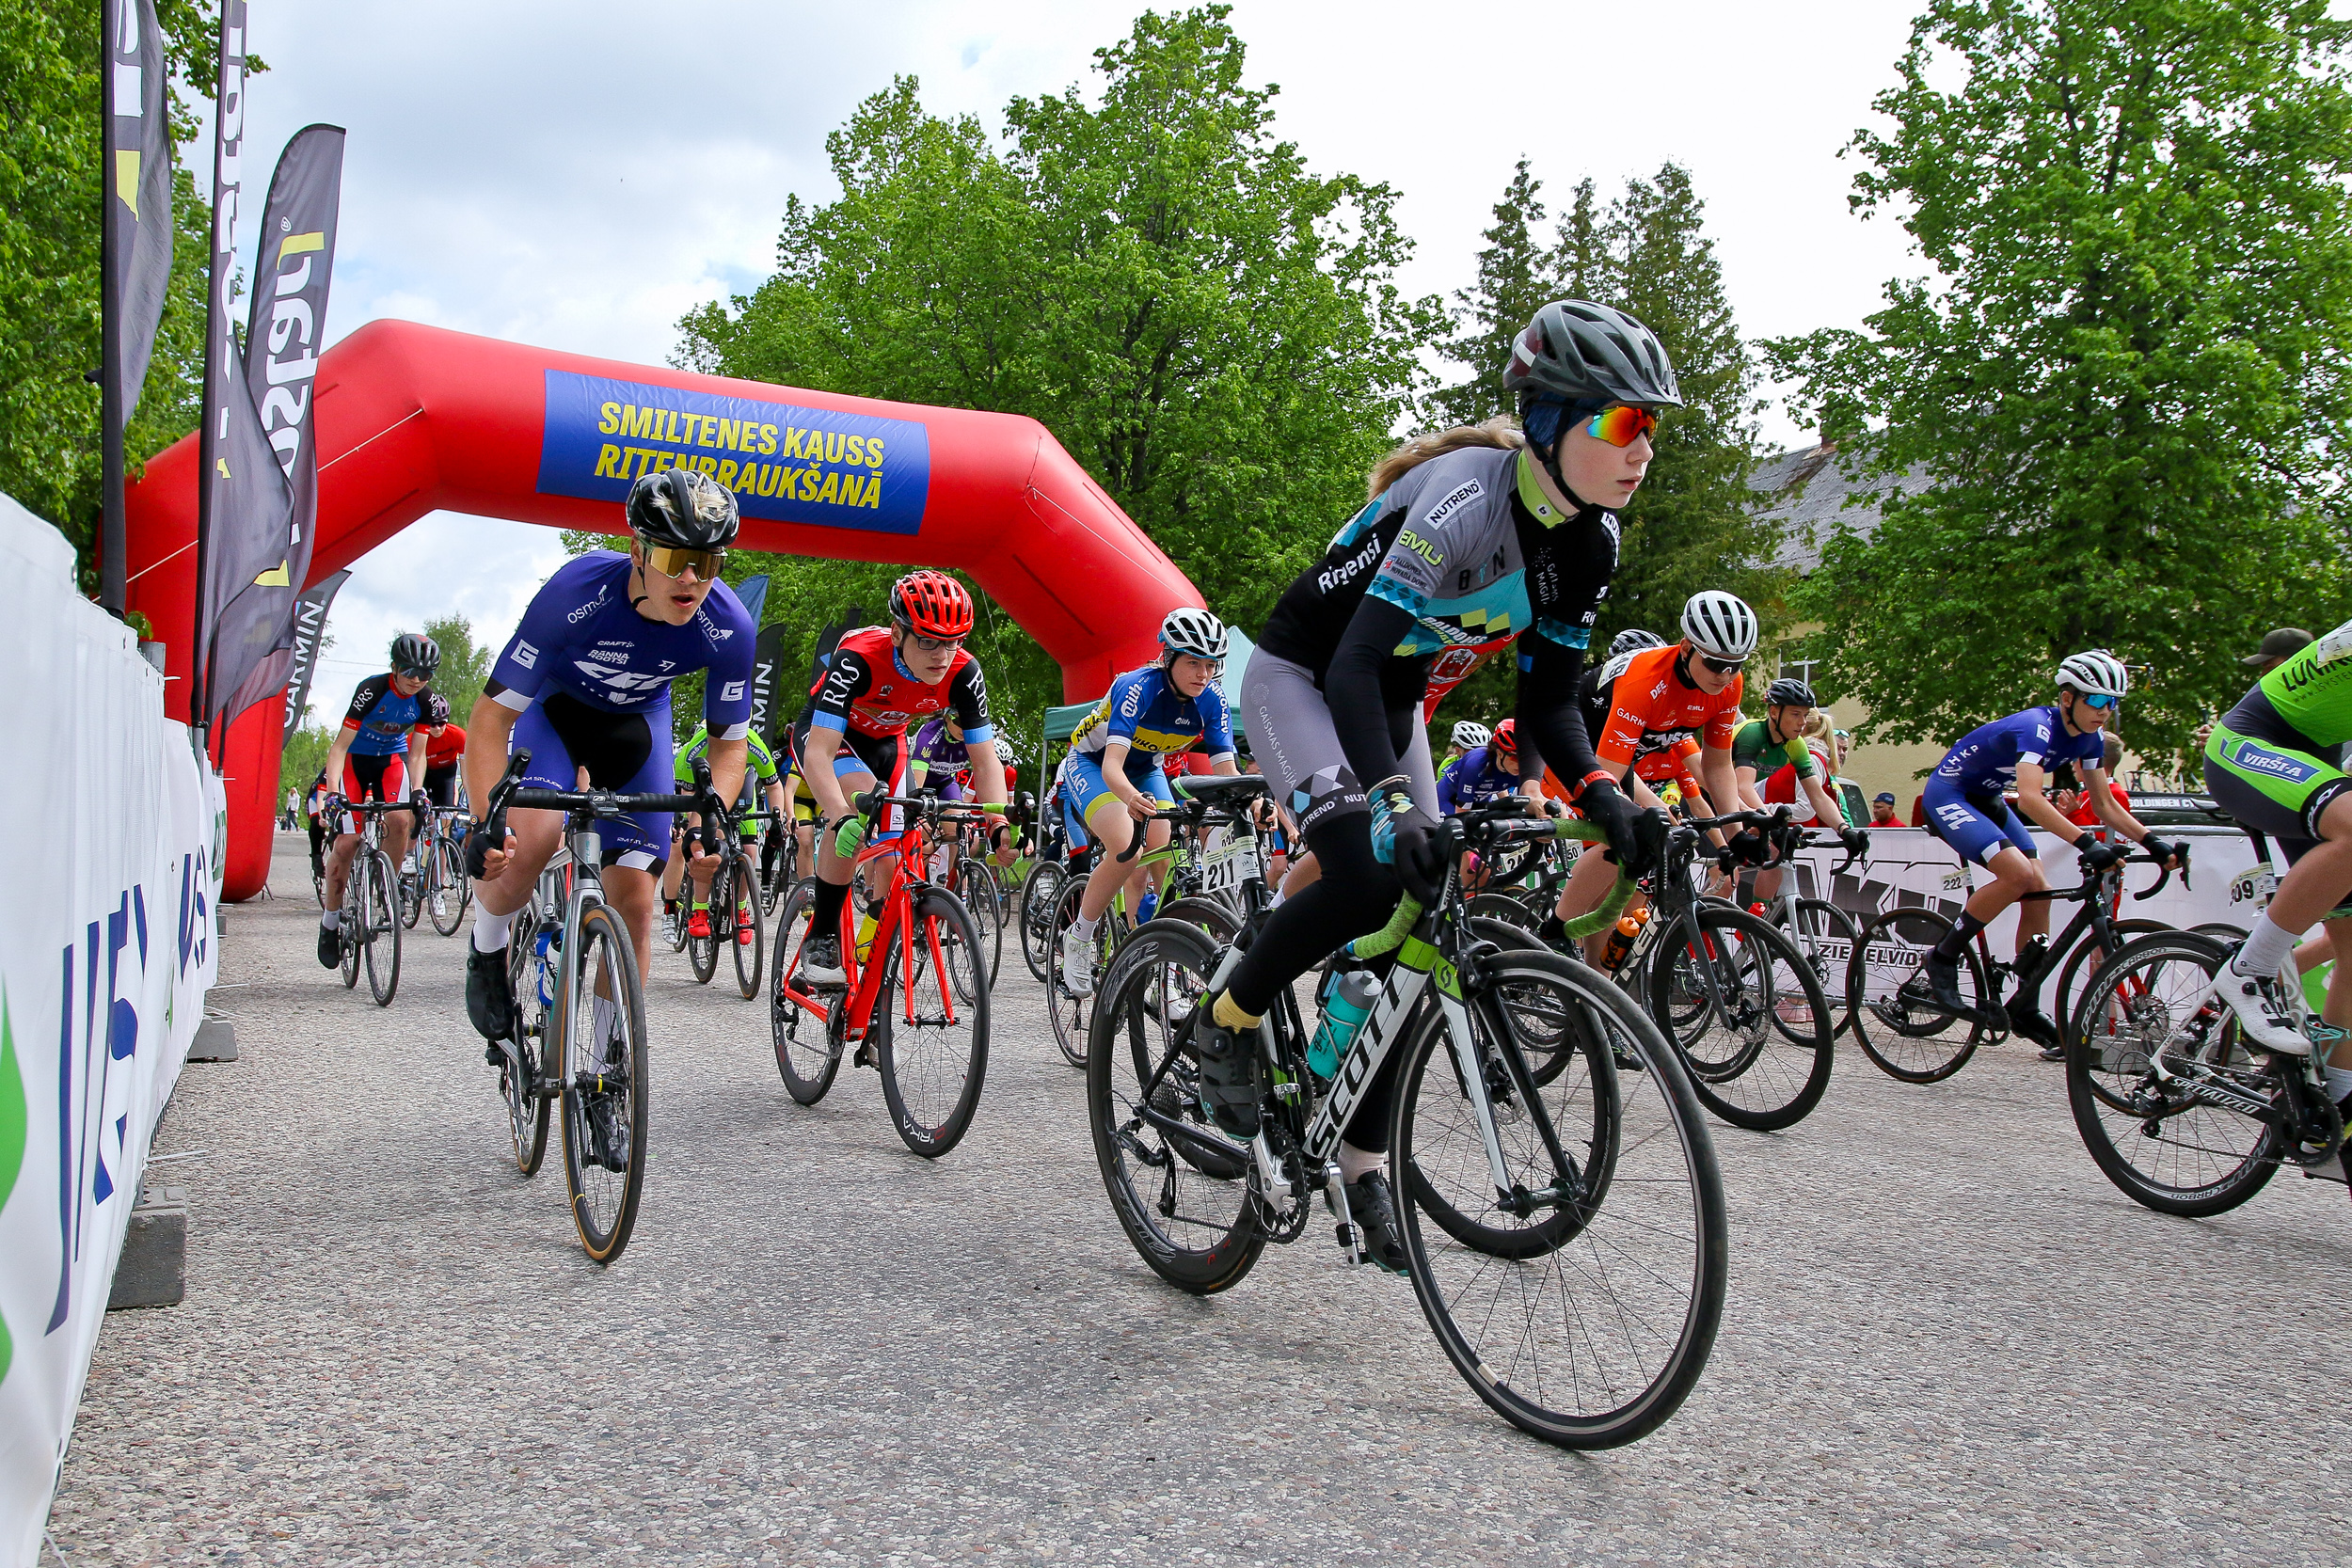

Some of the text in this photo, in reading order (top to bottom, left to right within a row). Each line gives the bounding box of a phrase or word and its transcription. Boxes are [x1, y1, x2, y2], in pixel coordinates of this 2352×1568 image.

[596, 400, 885, 469] SMILTENES KAUSS
[1429, 481, 1480, 524] NUTREND
[1398, 529, 1445, 566] EMU
[1390, 566, 1411, 582] NOVADA
[1395, 556, 1422, 577] BALDONES
[352, 688, 374, 712] RRS
[821, 657, 861, 708] RRS
[1208, 682, 1230, 734] NIKOLAEV
[2243, 754, 2303, 778] VIRŠI-A
[1207, 858, 1234, 891] 211
[1942, 876, 1963, 891] 222
[719, 915, 729, 935] BMC
[1311, 974, 1402, 1155] SCOTT
[2170, 1077, 2260, 1114] SPECIALIZED
